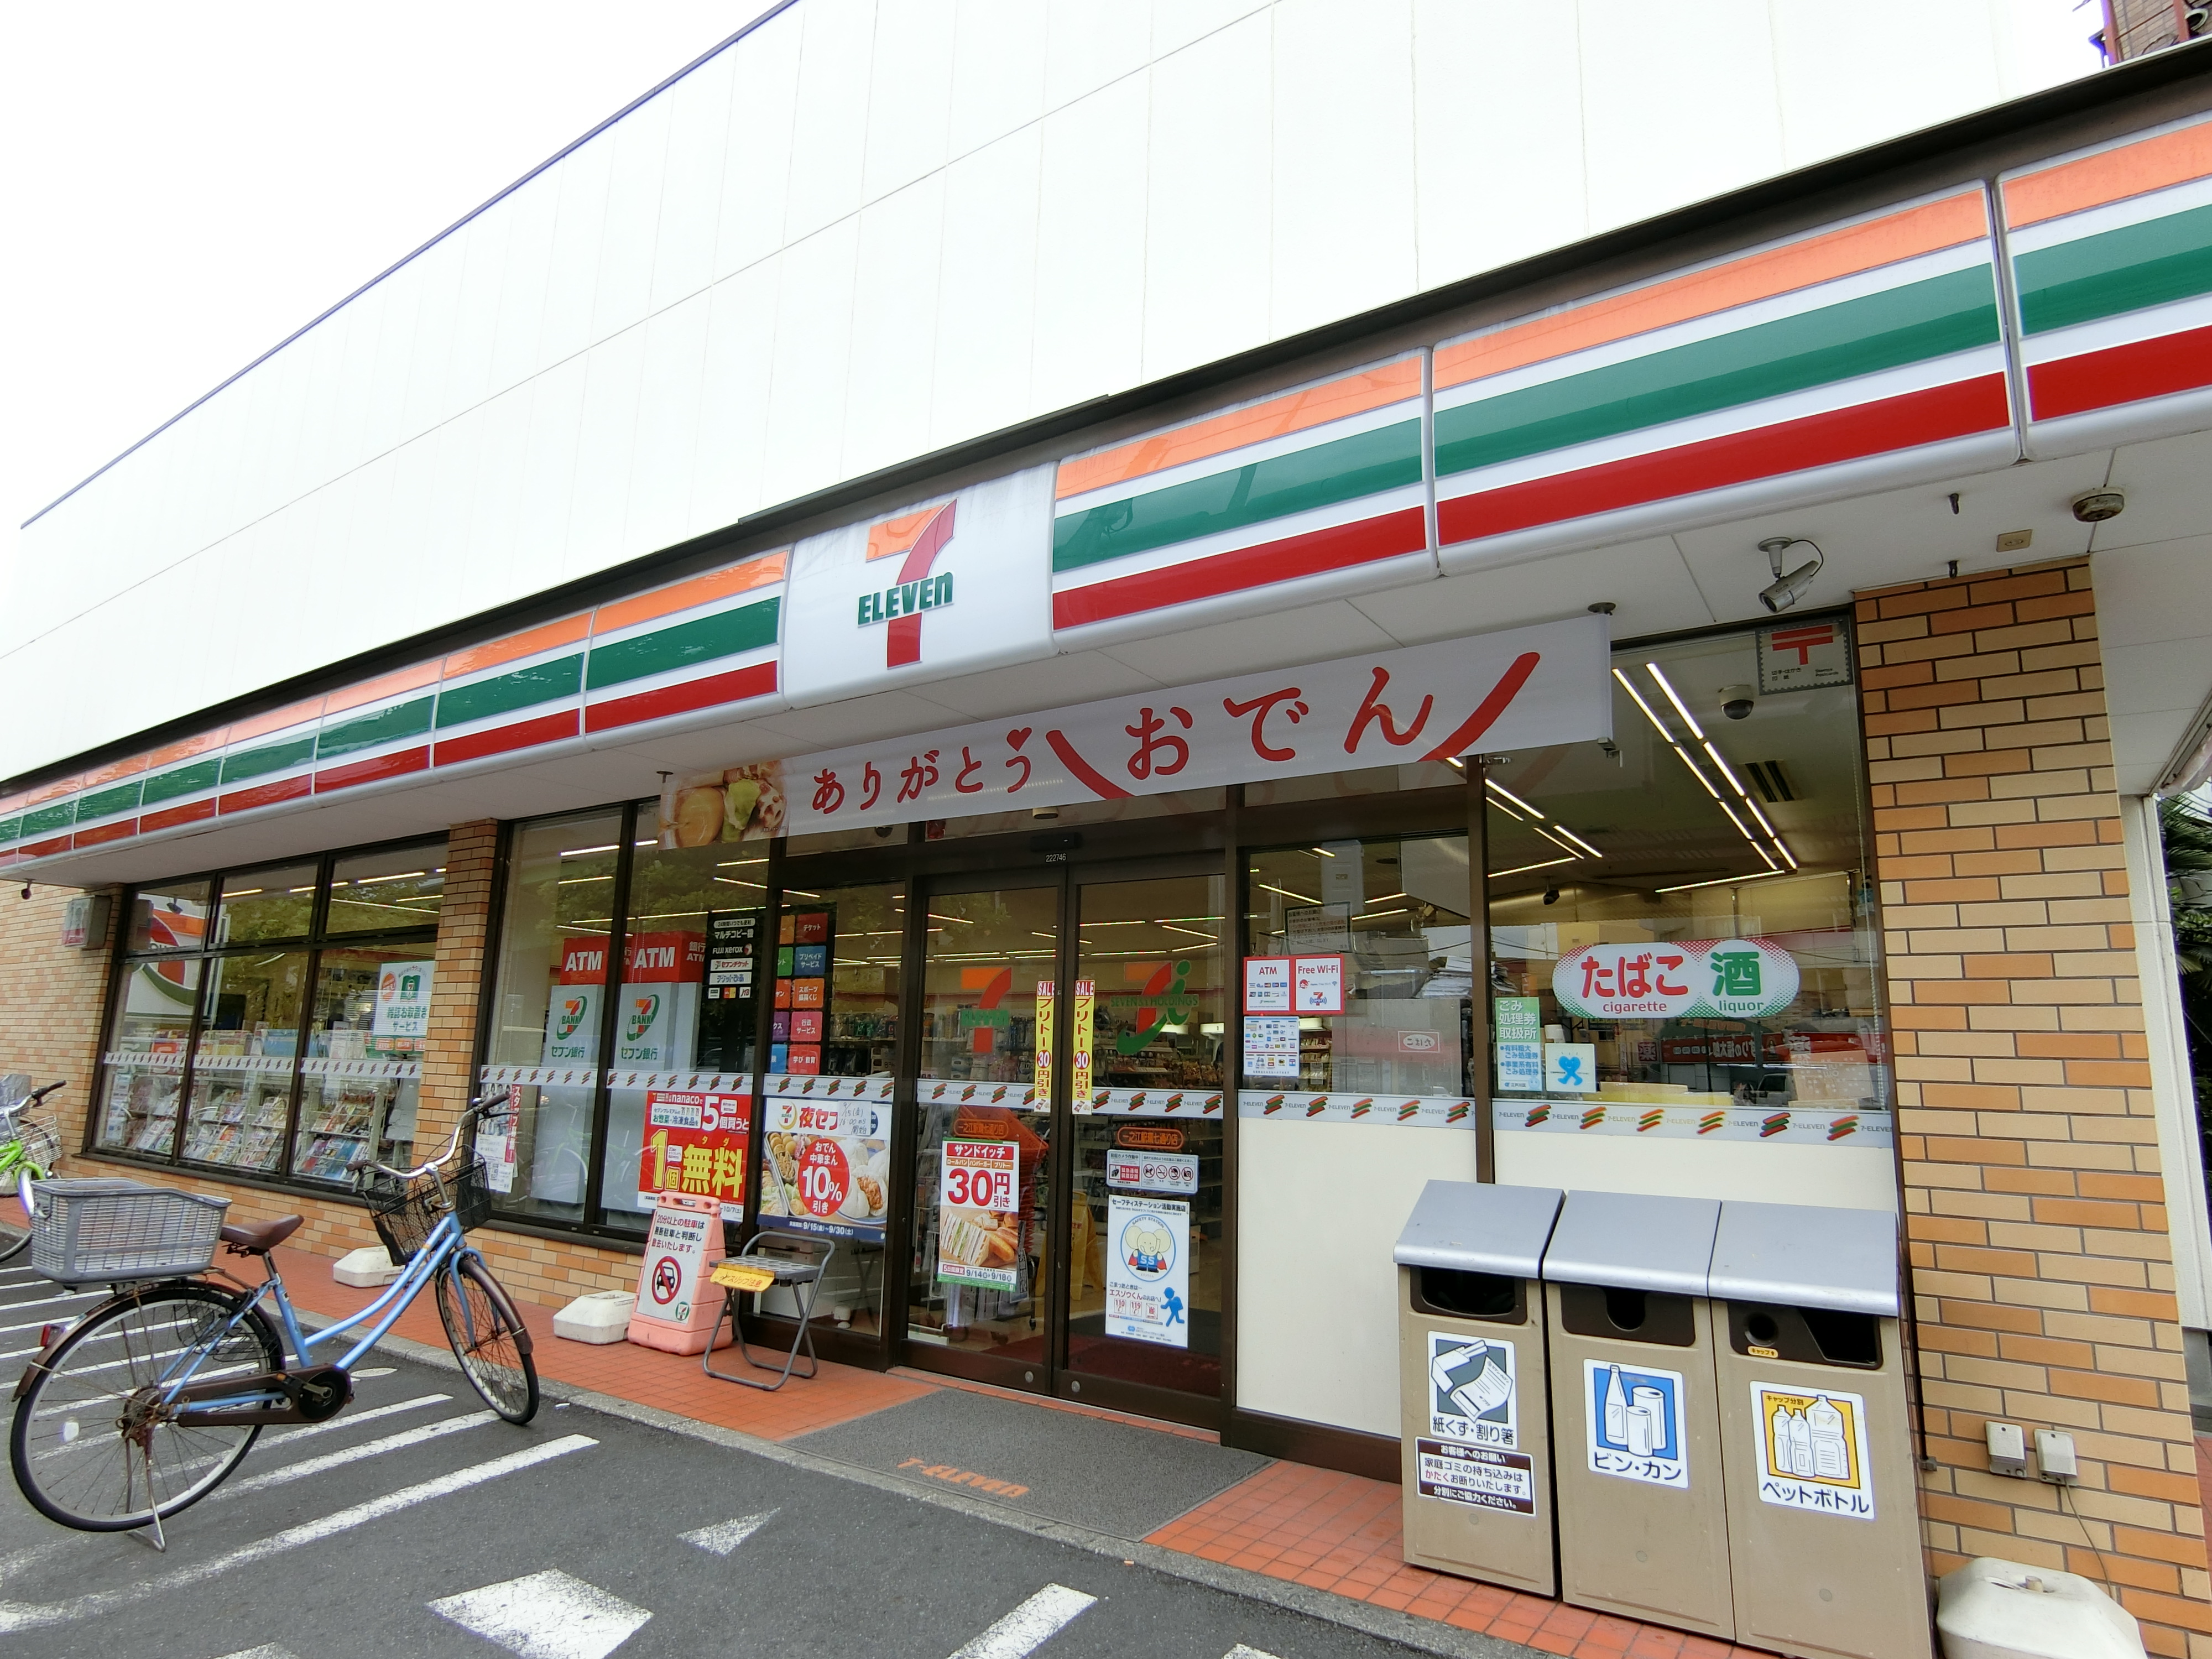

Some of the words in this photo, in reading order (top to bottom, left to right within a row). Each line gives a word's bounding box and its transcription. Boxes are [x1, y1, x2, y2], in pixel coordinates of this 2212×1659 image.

[1125, 666, 1433, 780] おでん
[812, 735, 1031, 815] ありがとう
[1046, 853, 1066, 862] 222746
[565, 951, 603, 971] ATM
[634, 947, 675, 969] ATM
[1259, 967, 1277, 975] ATM
[1298, 966, 1315, 974] Free
[1317, 964, 1338, 974] Wi-Fi
[1580, 951, 1689, 999] たばこ
[1710, 951, 1761, 996] 酒
[1076, 981, 1094, 996] SALE
[1151, 995, 1198, 1006] HOLDINGS
[1499, 1000, 1523, 1012] ごみ
[1603, 1000, 1667, 1014] cigarette
[1719, 998, 1764, 1014] liquor
[393, 1021, 418, 1032] サービス
[562, 1015, 580, 1024] BANK
[632, 1015, 652, 1024] BANK
[1076, 997, 1092, 1048] ブリトー
[1499, 1013, 1536, 1025] 処理券
[1499, 1027, 1537, 1040] 取扱所
[551, 1046, 585, 1058] セブン銀行
[621, 1046, 658, 1060] セブン銀行
[1038, 1051, 1050, 1067] 30
[1076, 1052, 1088, 1069] 30
[1037, 1070, 1050, 1097] 円引き
[1075, 1071, 1088, 1098] 円引き
[702, 1095, 719, 1131] 5
[816, 1141, 836, 1153] おでん
[954, 1145, 1005, 1159] サンドイッチ
[810, 1153, 838, 1166] 中華まん
[682, 1144, 743, 1198] 無料
[802, 1166, 843, 1202] 10%
[812, 1200, 829, 1214] 引き
[993, 1195, 1010, 1208] 引き
[656, 1214, 705, 1229] 20分以上の駐車は
[1132, 1217, 1147, 1225] SAFETY
[1148, 1217, 1164, 1228] STATION
[654, 1226, 702, 1241] 無断駐車と判断し
[1140, 1255, 1155, 1265] SS
[1766, 1395, 1804, 1406] キャップ分別
[1433, 1416, 1514, 1445] 紙くず・割り箸
[1441, 1445, 1506, 1463] お客様へのお願い
[1424, 1457, 1523, 1482] 家庭ゴミの持ち込みは
[1594, 1452, 1681, 1481] ビン・カン
[1425, 1469, 1526, 1495] かたくお断りいたします。
[1762, 1481, 1869, 1514] ペットボトル
